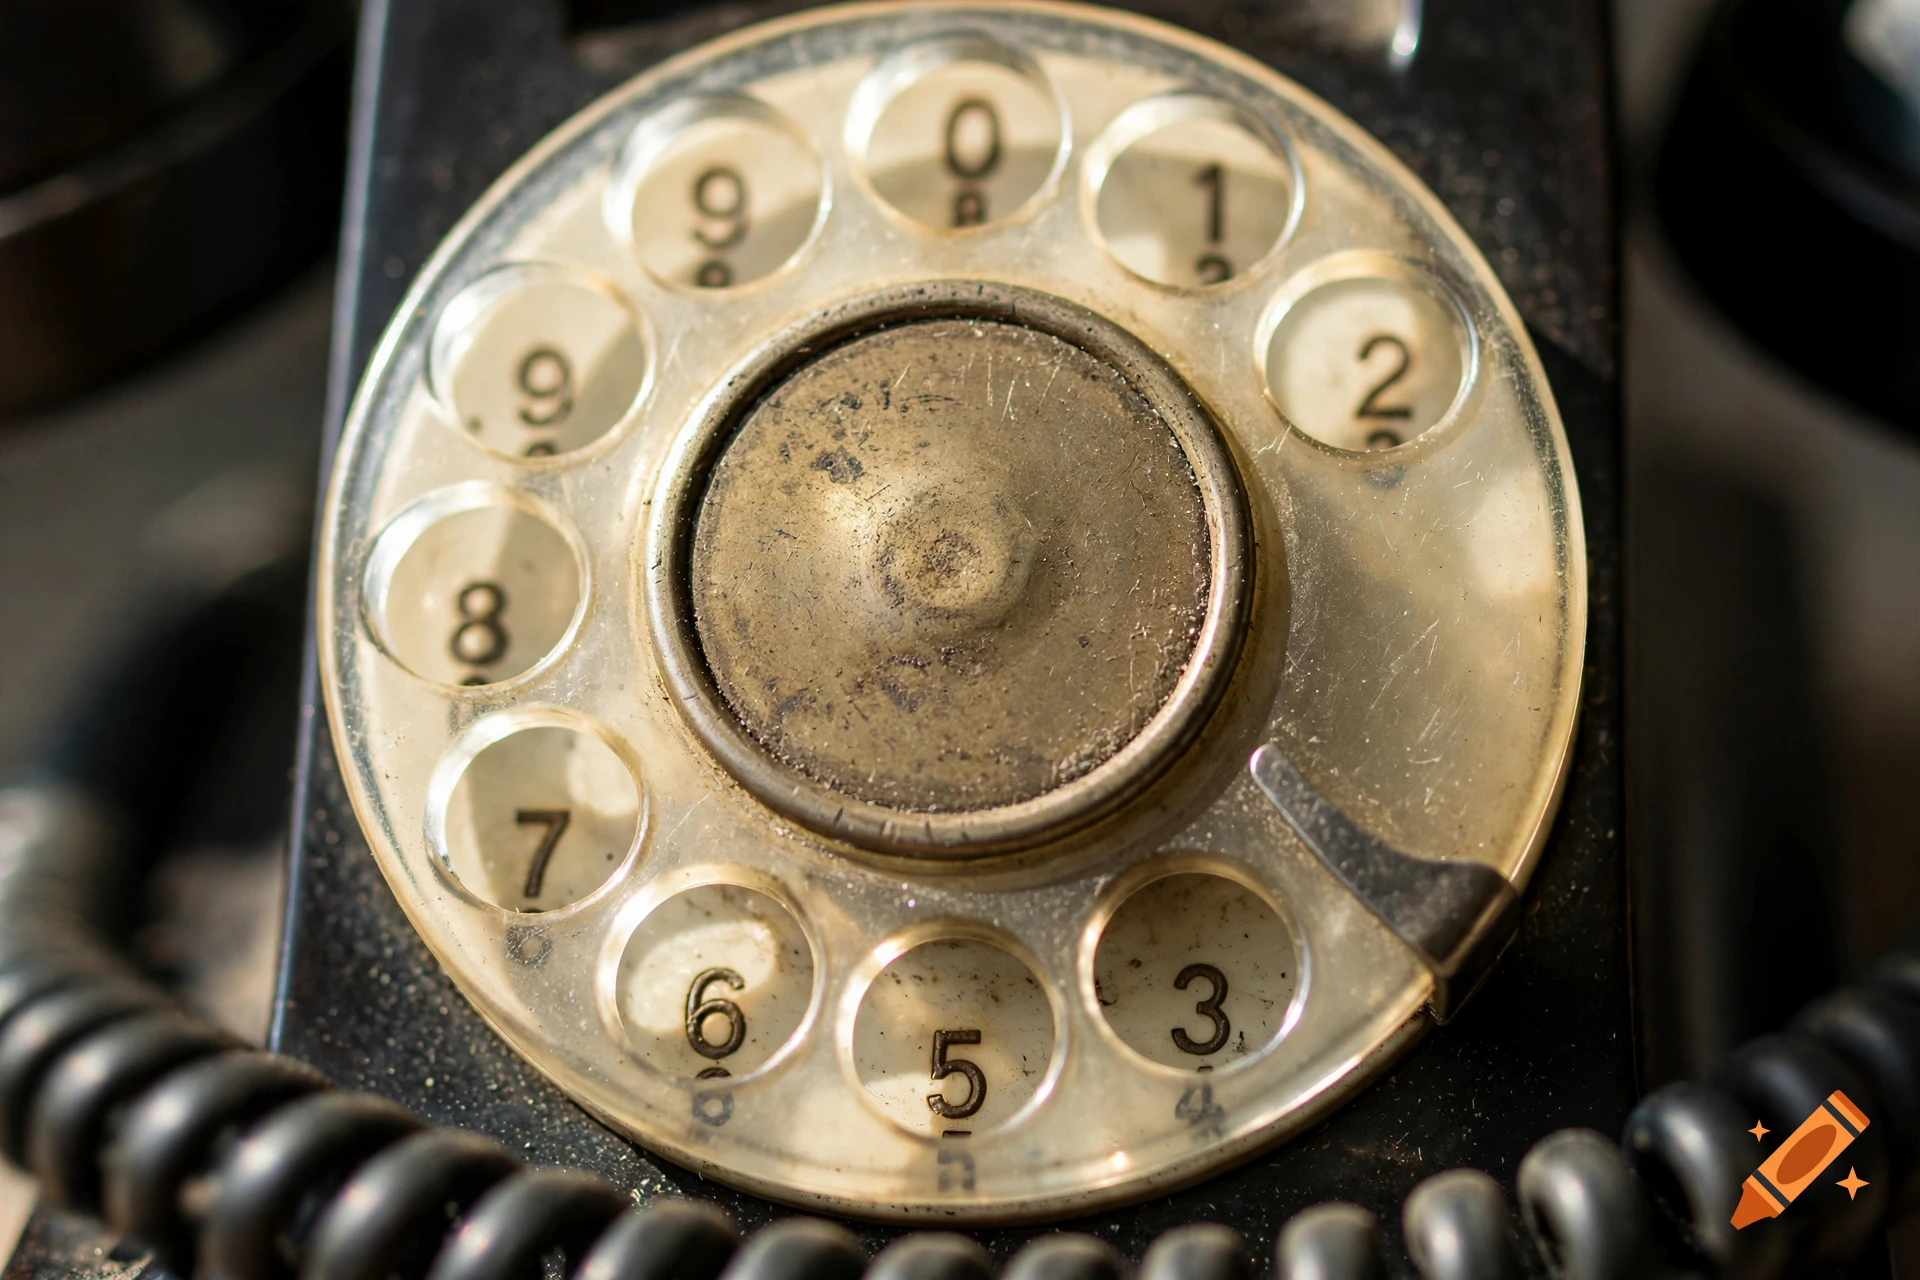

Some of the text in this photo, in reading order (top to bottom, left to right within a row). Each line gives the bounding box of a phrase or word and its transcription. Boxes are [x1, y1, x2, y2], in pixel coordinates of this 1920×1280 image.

[945, 98, 1001, 179] 0
[694, 165, 748, 249] 9
[1195, 163, 1224, 243] 1
[519, 348, 572, 427] 9
[1357, 335, 1411, 420] 2
[452, 583, 508, 665] 8
[516, 810, 570, 897] 7
[685, 967, 746, 1060] 6
[1171, 963, 1230, 1055] 3
[927, 1030, 987, 1119] 5
